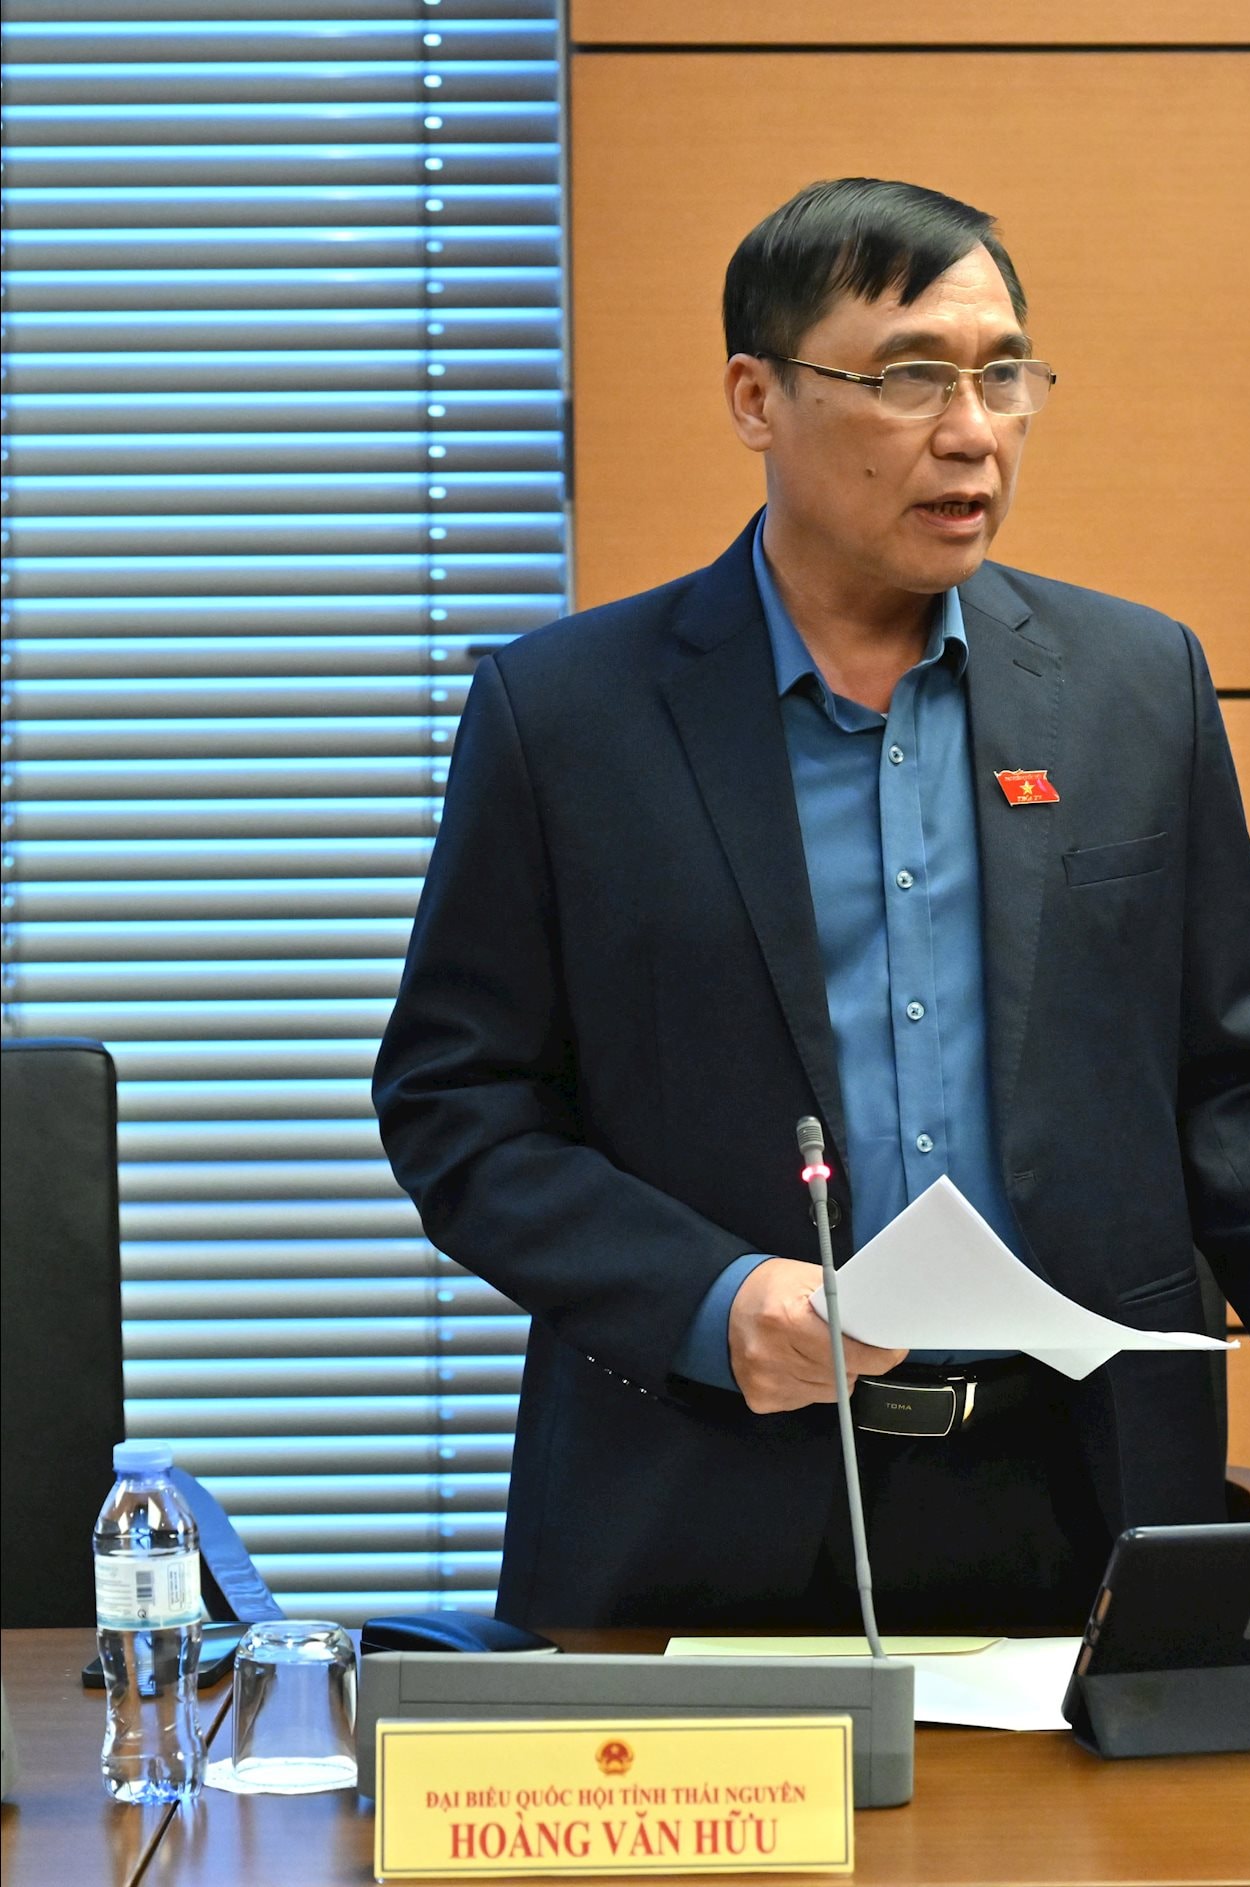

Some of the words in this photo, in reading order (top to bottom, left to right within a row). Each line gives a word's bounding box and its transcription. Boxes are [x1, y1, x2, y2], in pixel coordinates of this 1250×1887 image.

[885, 1402, 913, 1411] TOMA
[425, 1790, 460, 1813] ĐẠI
[578, 1786, 614, 1810] HỘI
[671, 1781, 720, 1805] THÁI
[726, 1780, 806, 1804] NGUYÊN
[449, 1810, 591, 1860] HOÀNG
[601, 1809, 682, 1857] VĂN
[693, 1808, 778, 1855] HỮU
